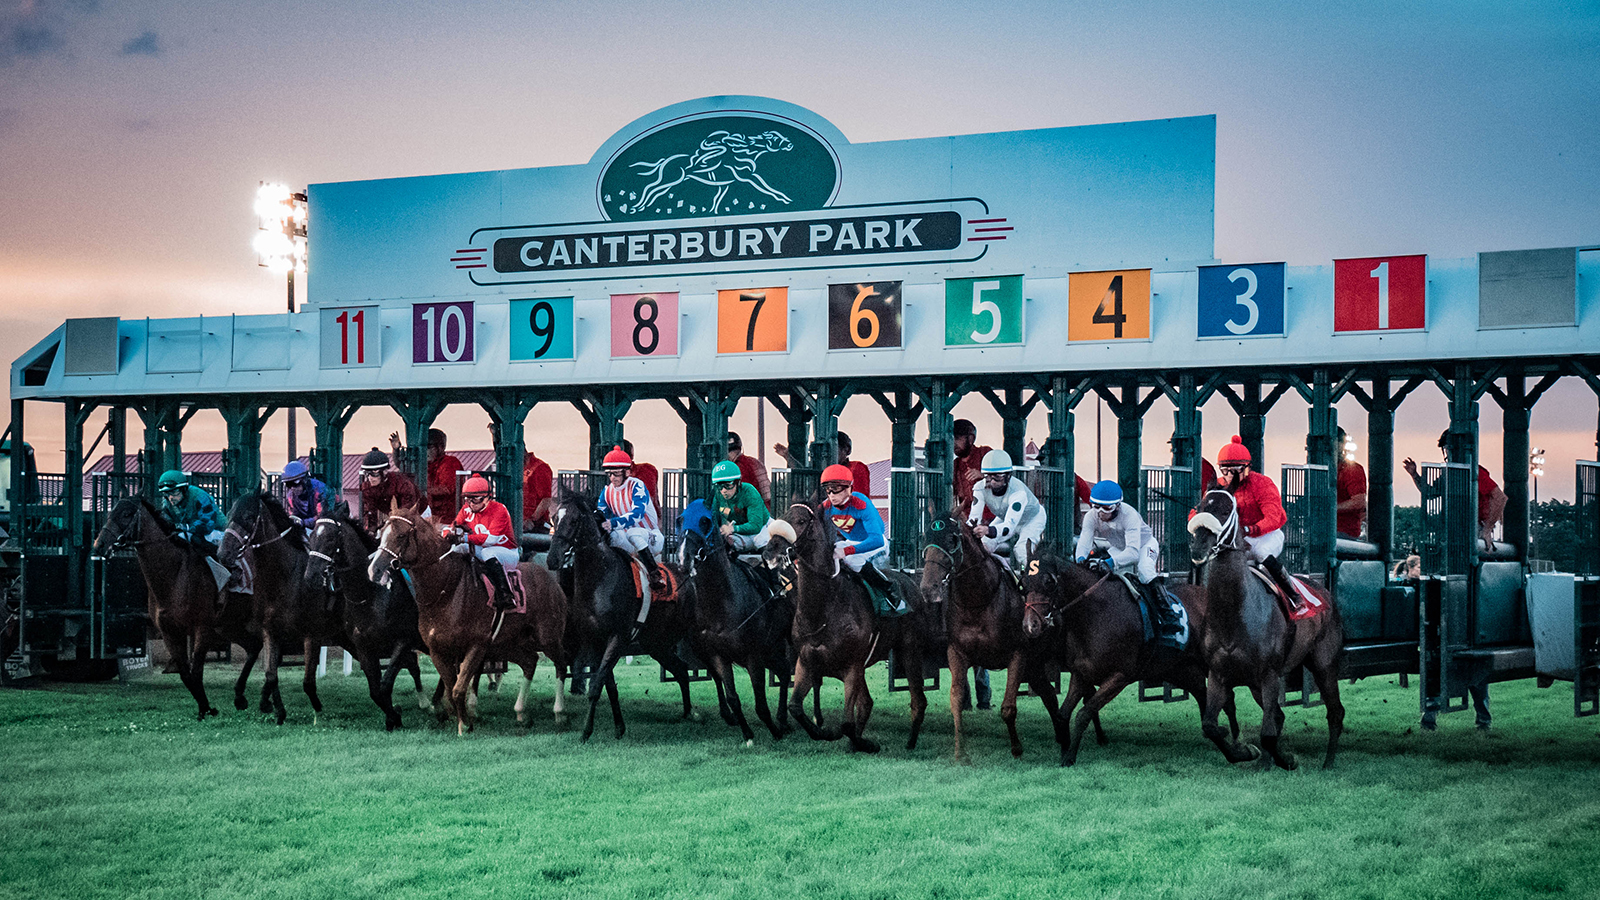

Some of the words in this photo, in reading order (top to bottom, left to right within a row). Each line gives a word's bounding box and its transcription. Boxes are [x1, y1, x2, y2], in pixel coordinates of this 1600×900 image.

[519, 226, 791, 267] CANTERBURY
[808, 218, 924, 253] PARK
[739, 292, 767, 351] 7
[849, 285, 881, 348] 6
[969, 281, 1002, 344] 5
[1092, 275, 1127, 338] 4
[1224, 268, 1260, 336] 3
[1370, 262, 1390, 329] 1
[335, 309, 365, 364] 11
[421, 304, 468, 362] 10
[529, 301, 555, 359] 9
[632, 296, 660, 355] 8
[1028, 560, 1040, 576] S
